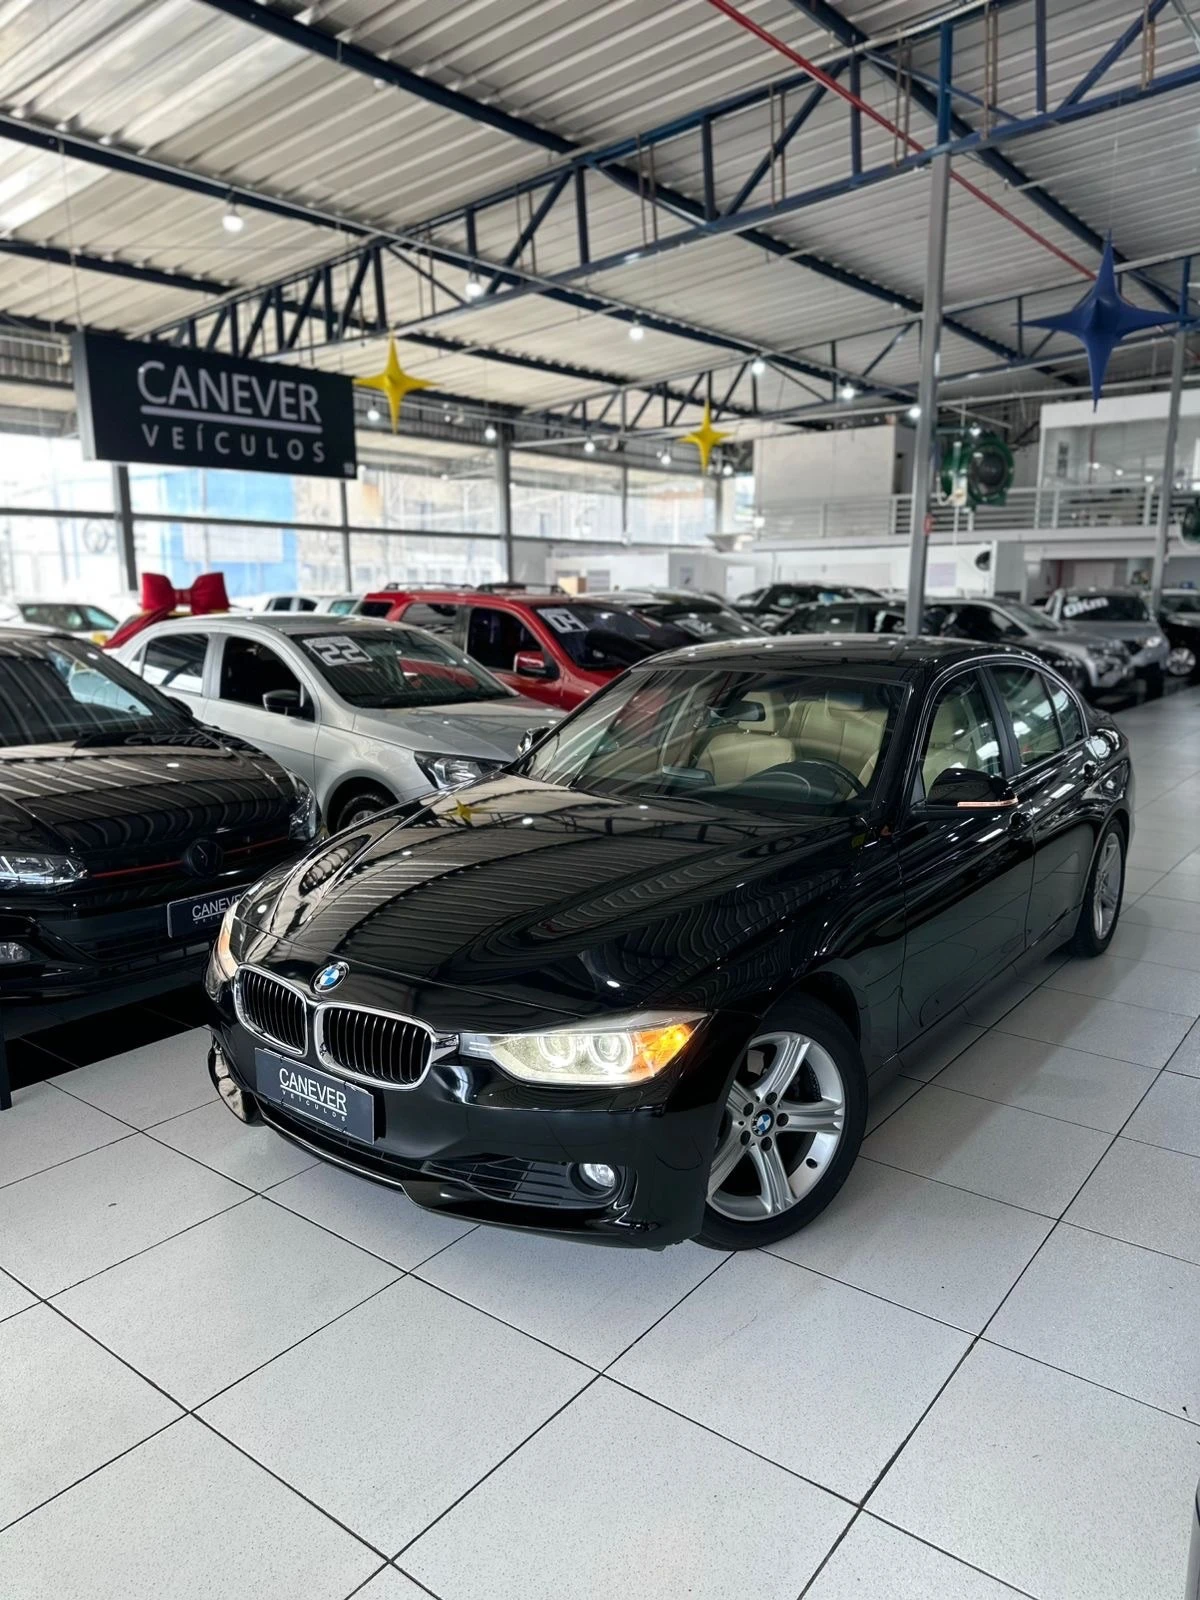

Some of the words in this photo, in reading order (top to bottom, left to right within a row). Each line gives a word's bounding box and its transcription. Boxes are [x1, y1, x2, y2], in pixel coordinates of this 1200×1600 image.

[137, 360, 322, 424] CANEVER
[141, 423, 325, 463] VEÍCULOS
[312, 642, 368, 663] 22
[279, 1067, 347, 1113] CANEVER
